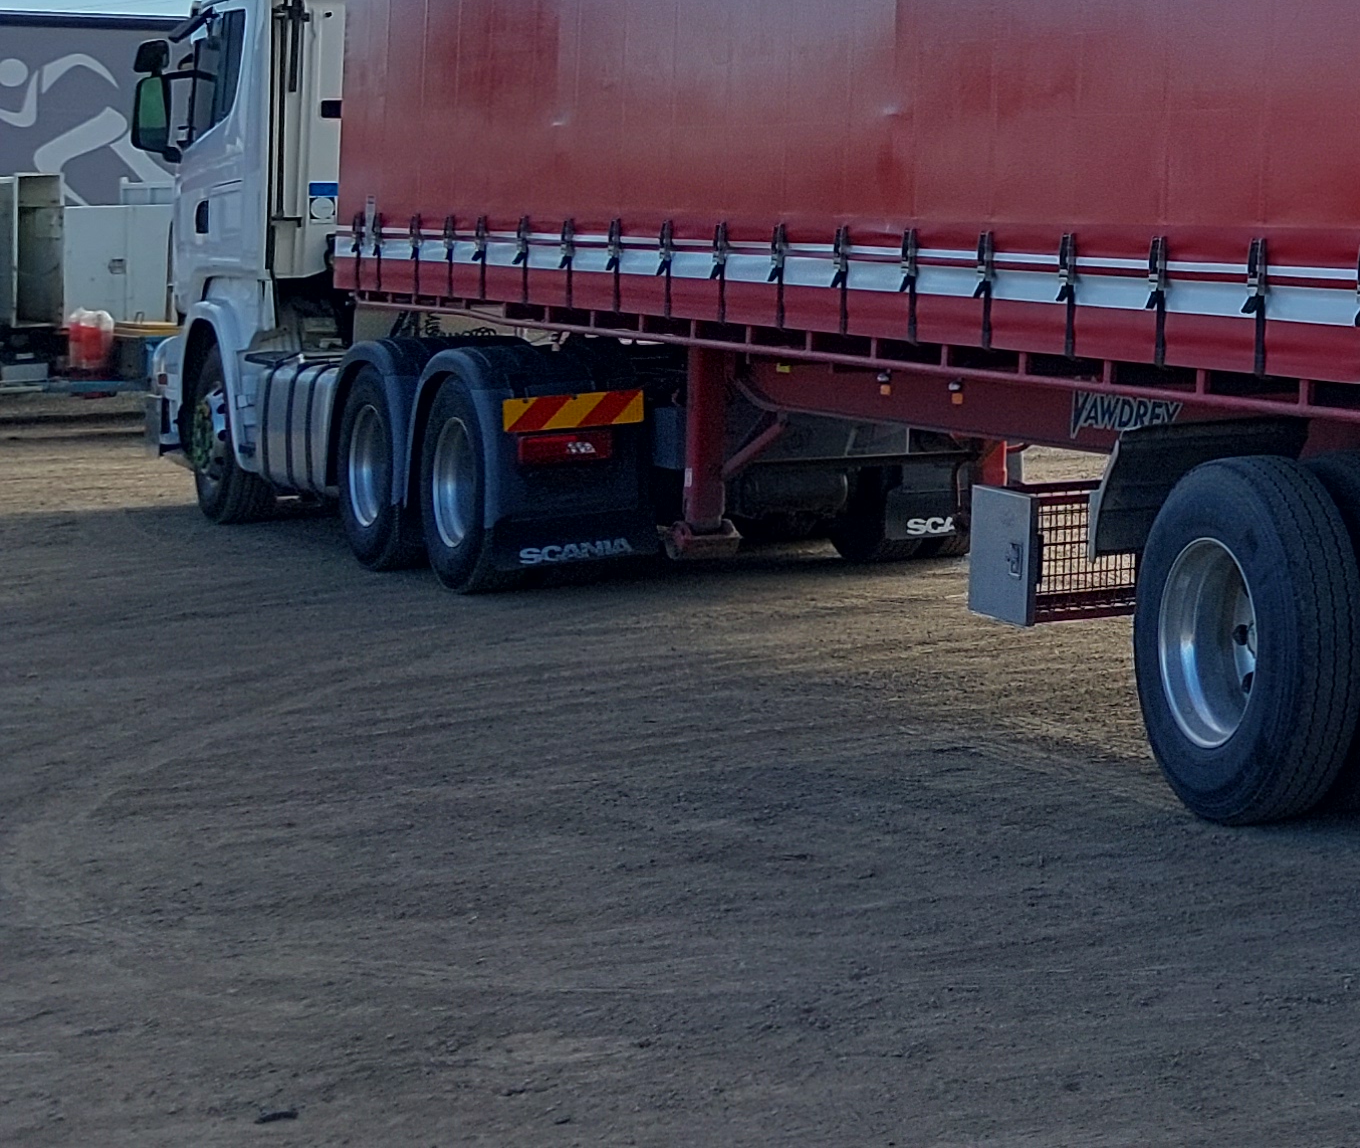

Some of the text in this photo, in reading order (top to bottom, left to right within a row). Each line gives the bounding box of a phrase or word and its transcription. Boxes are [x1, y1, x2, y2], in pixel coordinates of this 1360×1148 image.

[1070, 389, 1184, 440] VAWDREY
[906, 516, 956, 536] SCA
[519, 537, 633, 565] SCANIA
